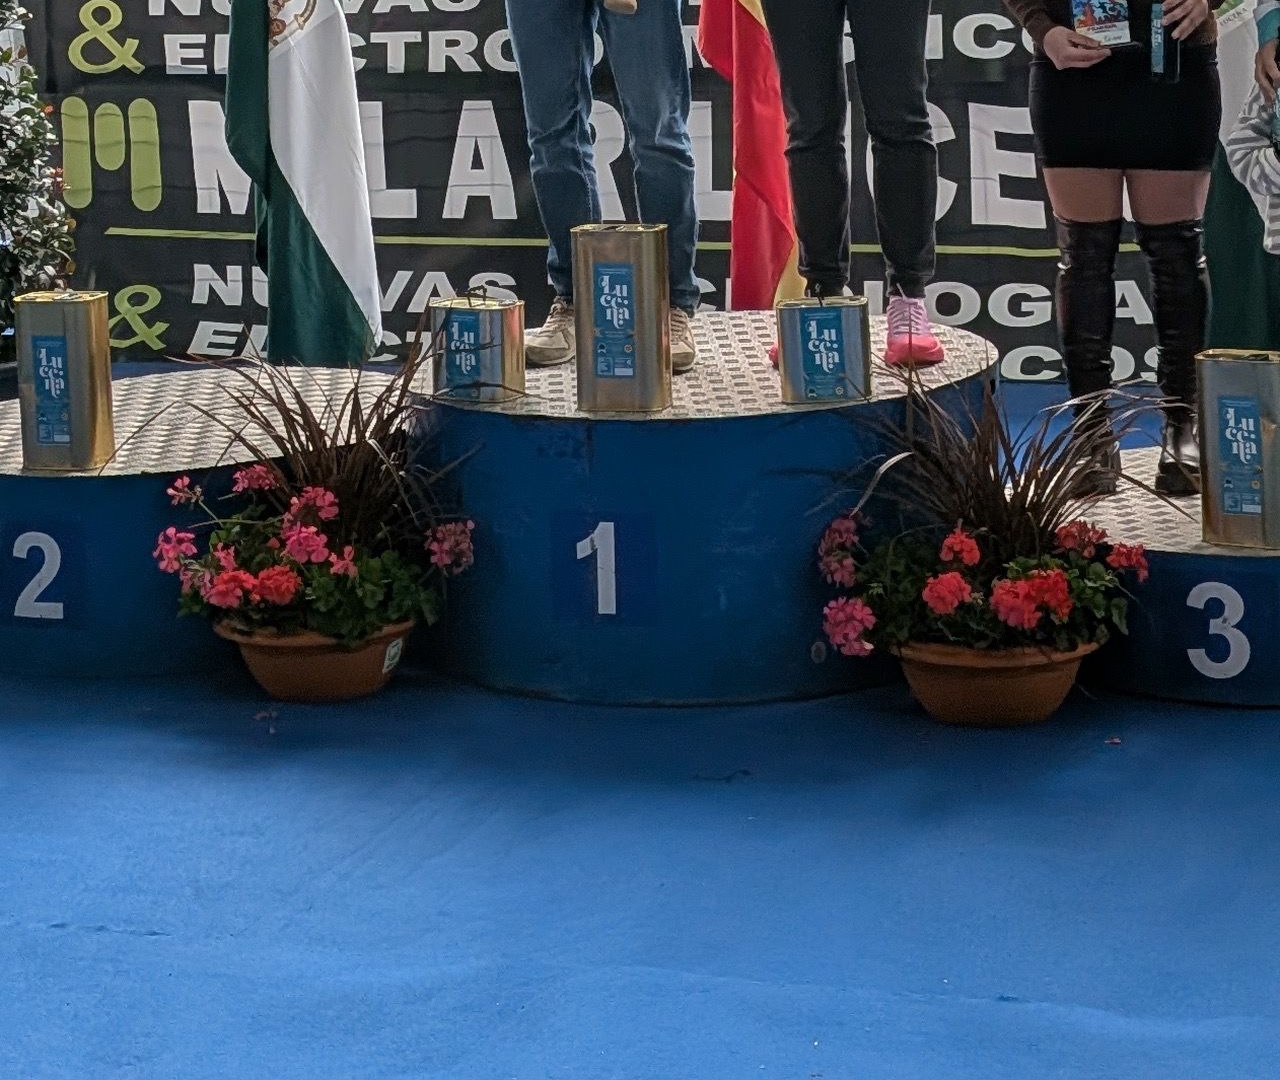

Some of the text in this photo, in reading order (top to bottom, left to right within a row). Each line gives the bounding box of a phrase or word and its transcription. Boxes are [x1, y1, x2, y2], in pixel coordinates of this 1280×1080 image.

[12, 531, 65, 621] 2
[576, 521, 617, 616] 1
[1185, 581, 1251, 680] 3
